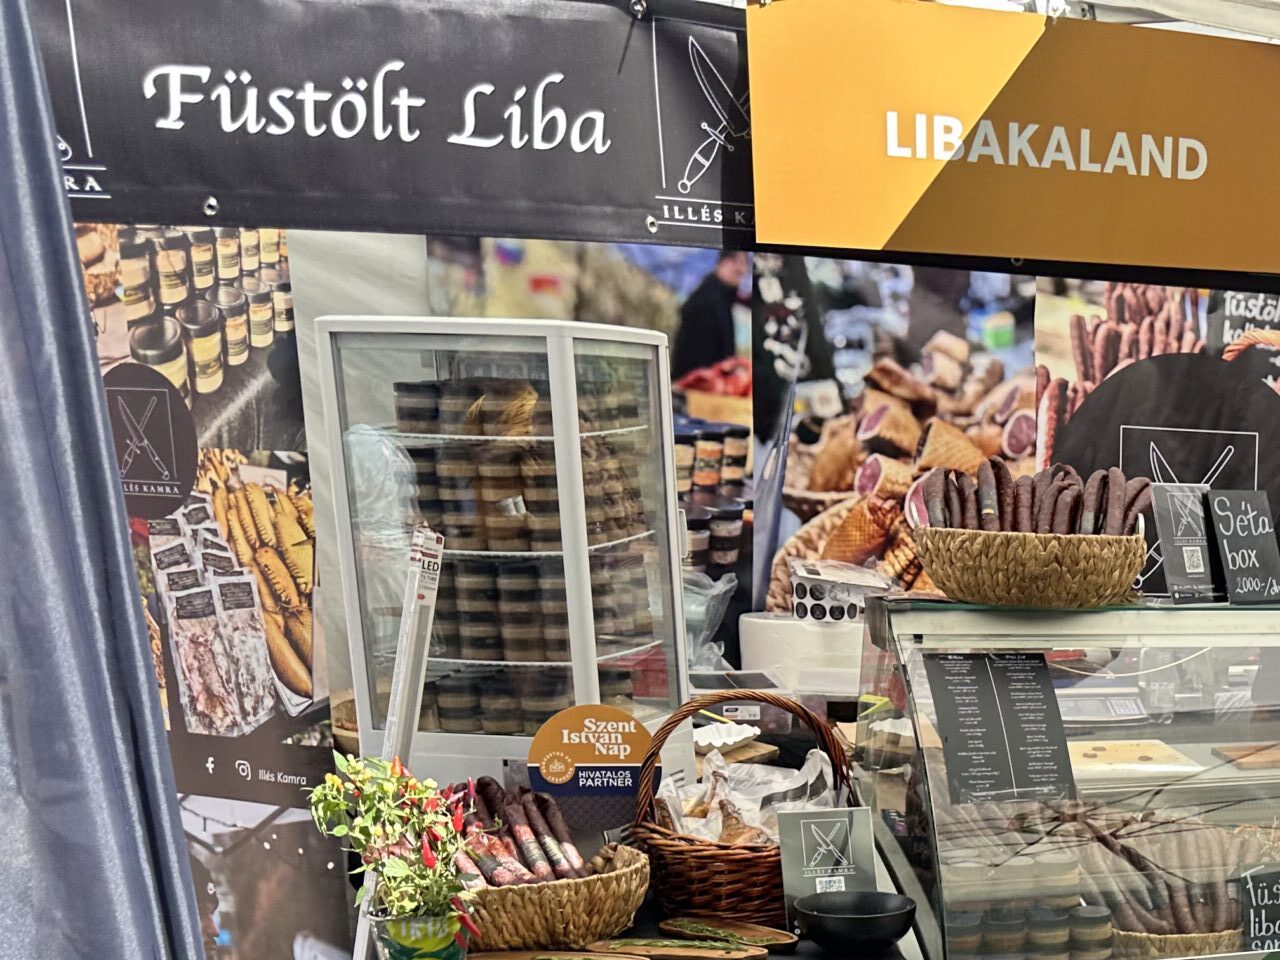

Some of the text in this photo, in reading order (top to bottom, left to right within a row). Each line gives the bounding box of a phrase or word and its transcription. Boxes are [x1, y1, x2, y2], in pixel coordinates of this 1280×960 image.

[144, 61, 612, 155] Füstölt Liba
[886, 111, 1208, 181] LIBAKALAND
[663, 204, 724, 223] ILLÉS
[142, 485, 180, 494] KAMRA
[1213, 496, 1274, 537] Séta
[1222, 539, 1261, 571] box
[421, 559, 440, 572] LED
[583, 717, 638, 733] Szent
[595, 742, 632, 760] Nap
[258, 769, 307, 786] Illés Kamra
[578, 770, 632, 779] HIVATALOS
[578, 779, 633, 788] PARTNER
